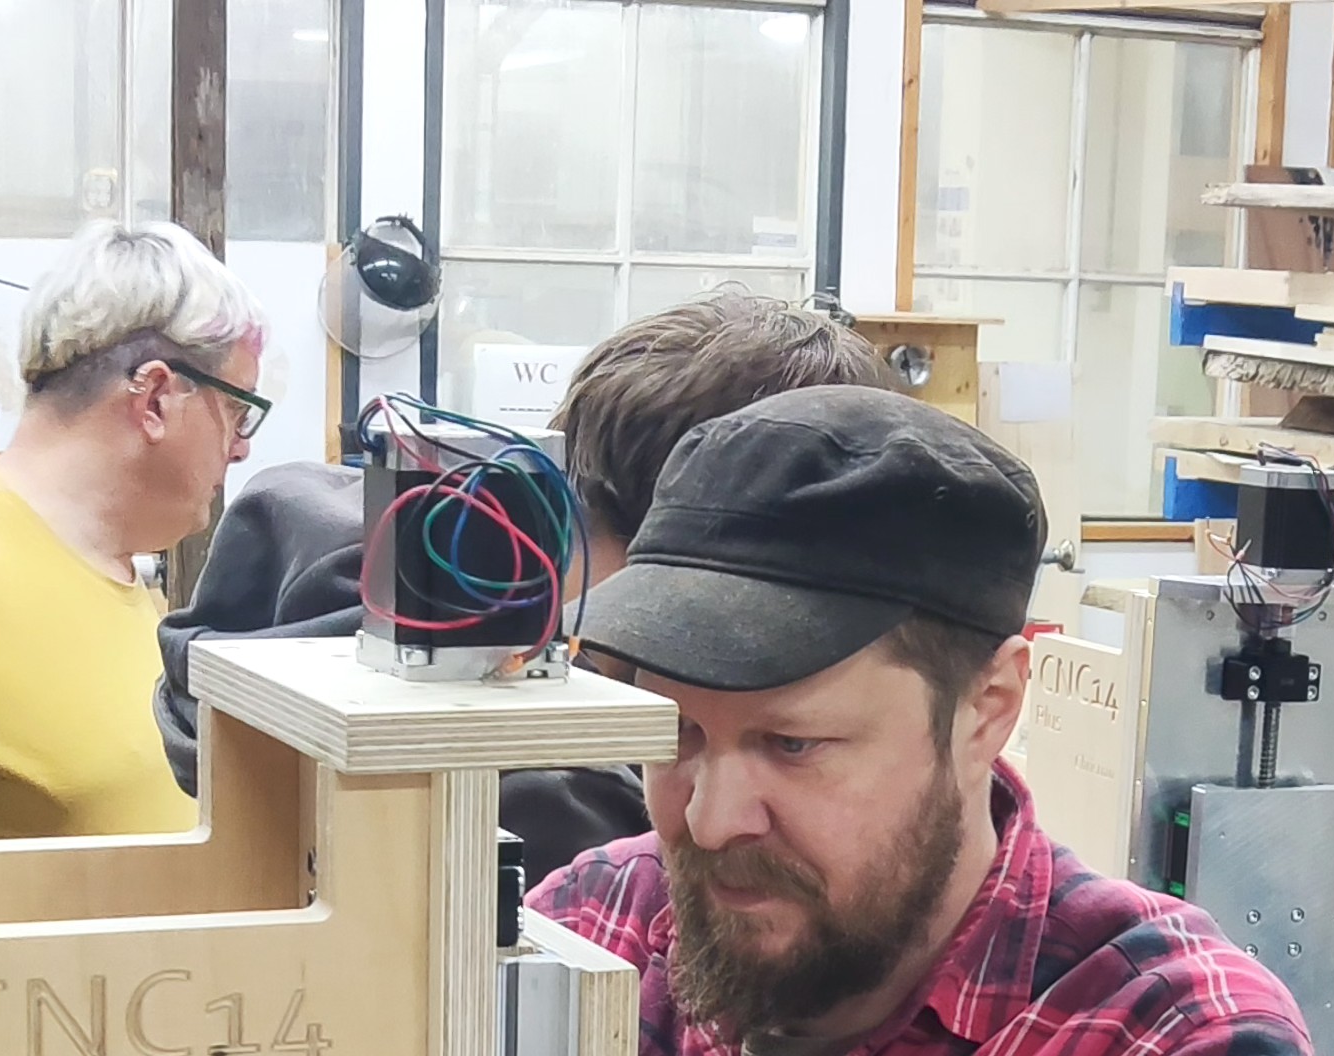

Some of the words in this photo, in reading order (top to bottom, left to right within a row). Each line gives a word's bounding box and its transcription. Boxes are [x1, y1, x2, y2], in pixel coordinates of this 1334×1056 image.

[513, 362, 558, 385] WC
[1039, 653, 1119, 723] CNC14
[1035, 704, 1063, 733] Plus
